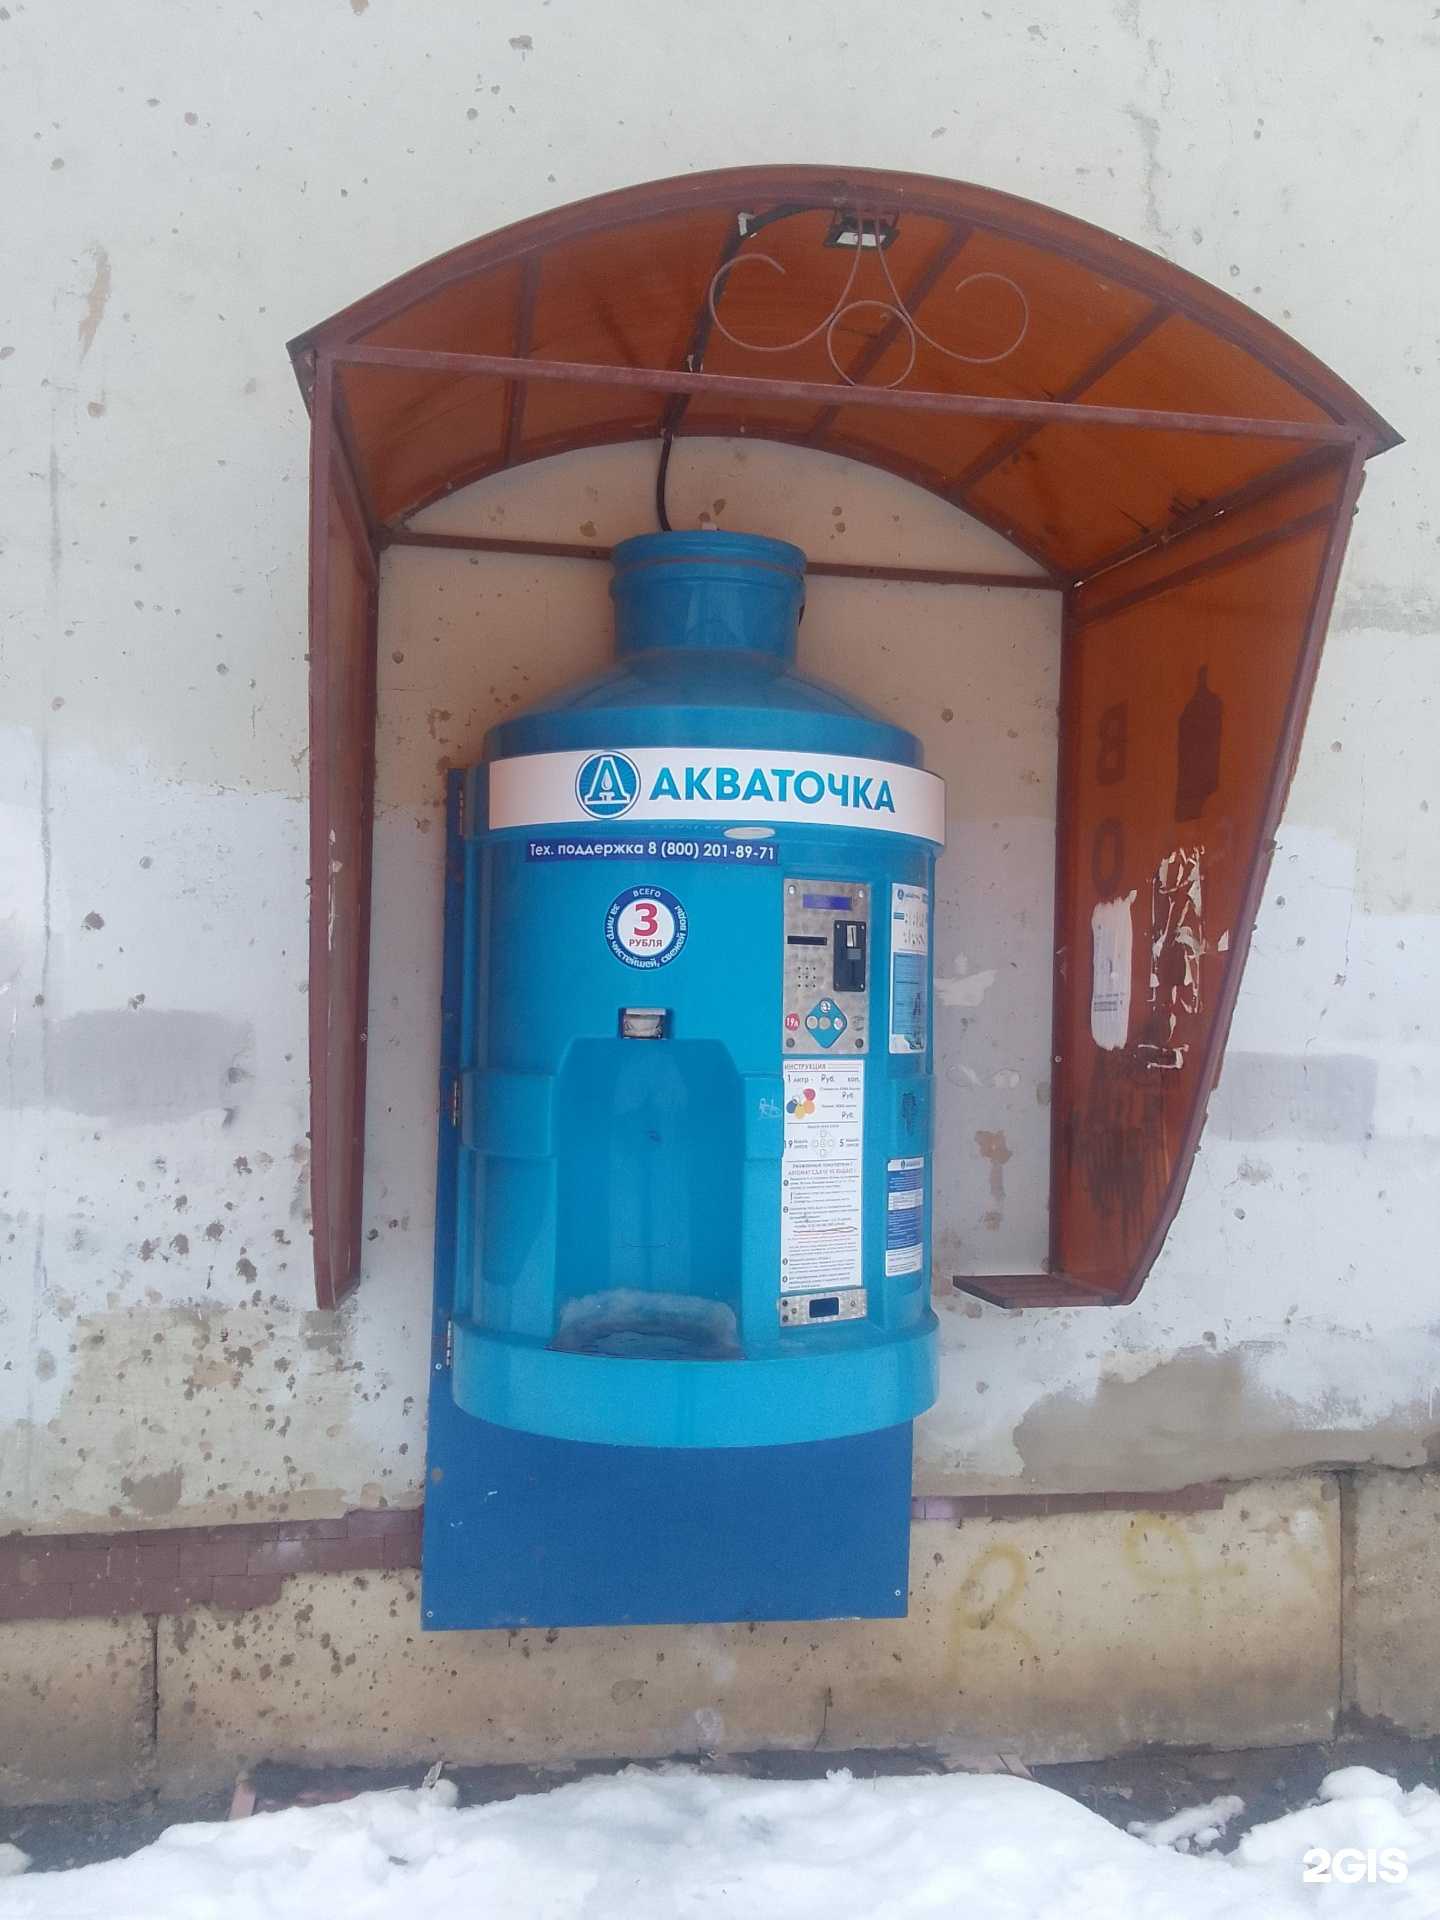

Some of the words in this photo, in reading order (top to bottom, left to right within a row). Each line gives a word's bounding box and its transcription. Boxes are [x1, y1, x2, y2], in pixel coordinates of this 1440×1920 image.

[649, 766, 896, 813] АКВАТОЧКА
[529, 843, 554, 857] Тех.
[557, 843, 644, 857] поддержка
[647, 841, 658, 855] 8
[660, 841, 700, 859] (800)
[703, 843, 775, 861] 201-89-71
[632, 887, 662, 898] ВСЕГО
[633, 902, 658, 937] 3
[628, 938, 664, 948] РУБЛЯ
[784, 1063, 826, 1071] ИНСТРУКЦИЯ
